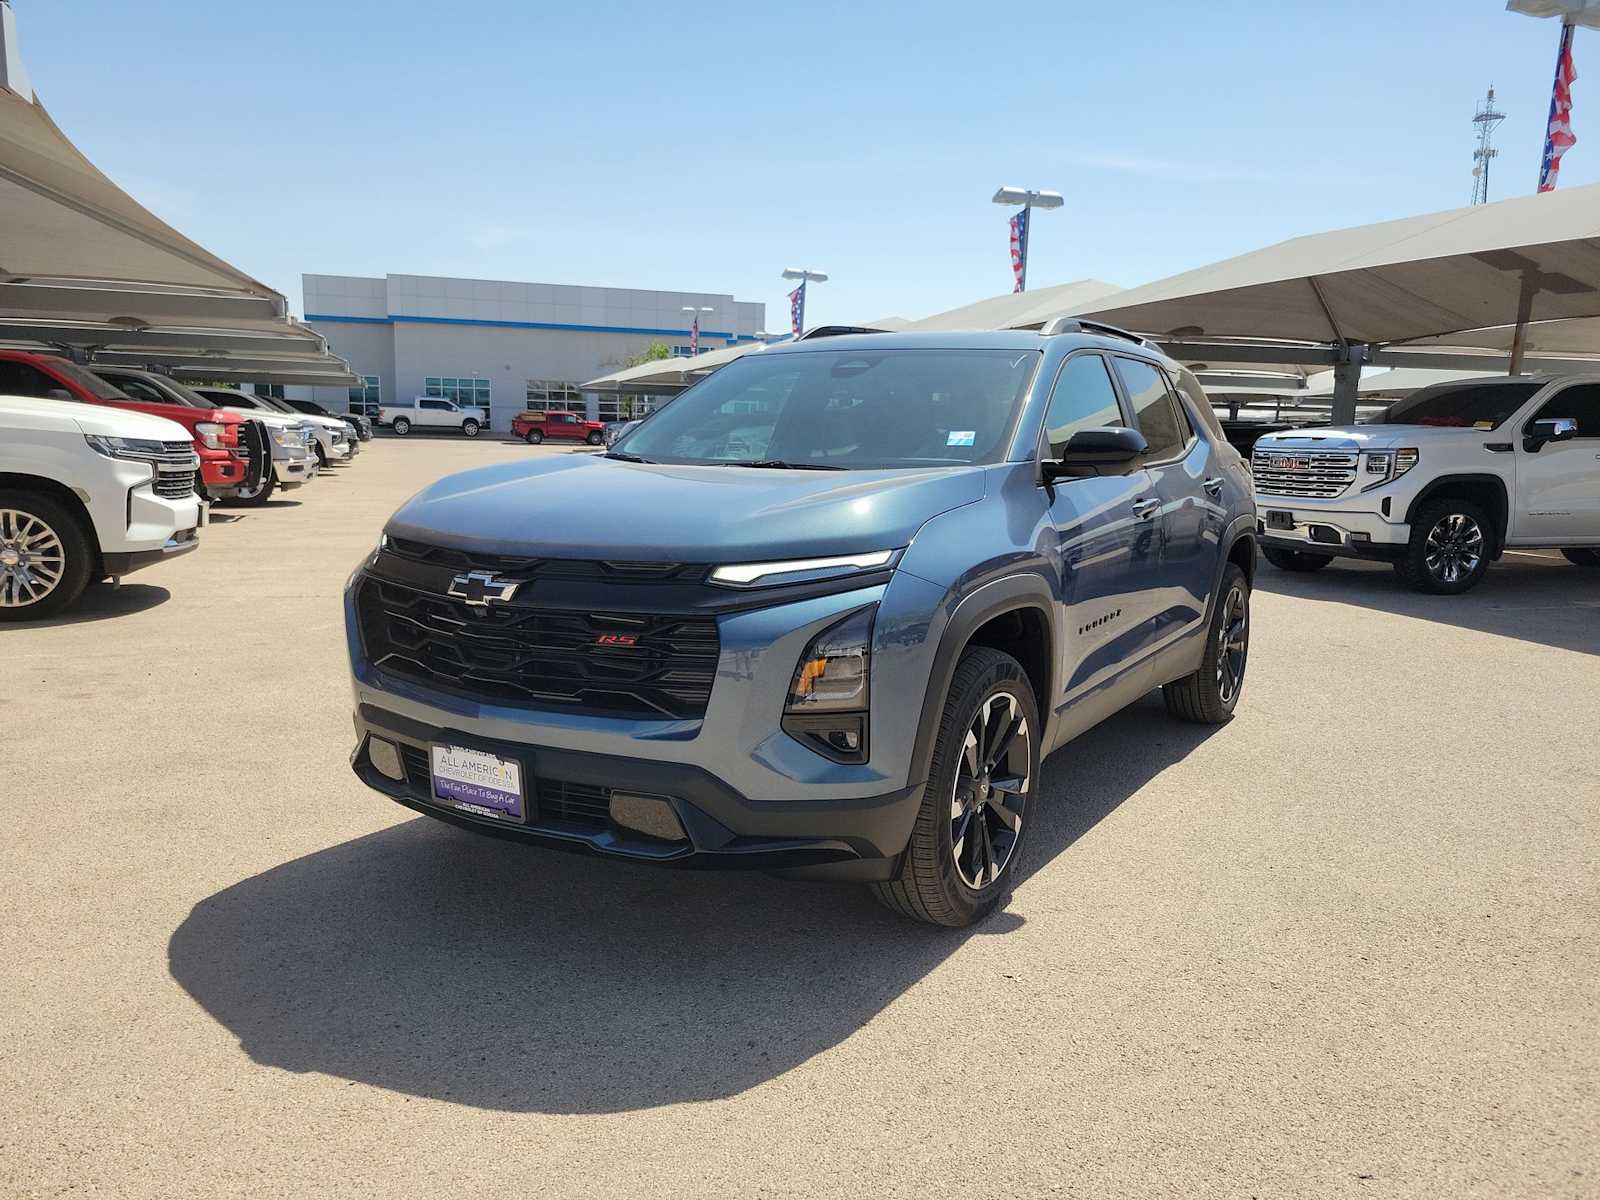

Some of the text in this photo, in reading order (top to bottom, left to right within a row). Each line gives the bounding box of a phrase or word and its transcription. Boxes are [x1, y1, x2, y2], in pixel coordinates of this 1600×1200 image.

[1272, 455, 1308, 468] GMC
[598, 634, 635, 644] RS
[441, 755, 512, 780] ALL AMERICN
[439, 779, 449, 788] The
[461, 784, 477, 796] Place
[478, 788, 484, 797] To
[486, 790, 498, 803] Buy
[498, 794, 504, 802] A
